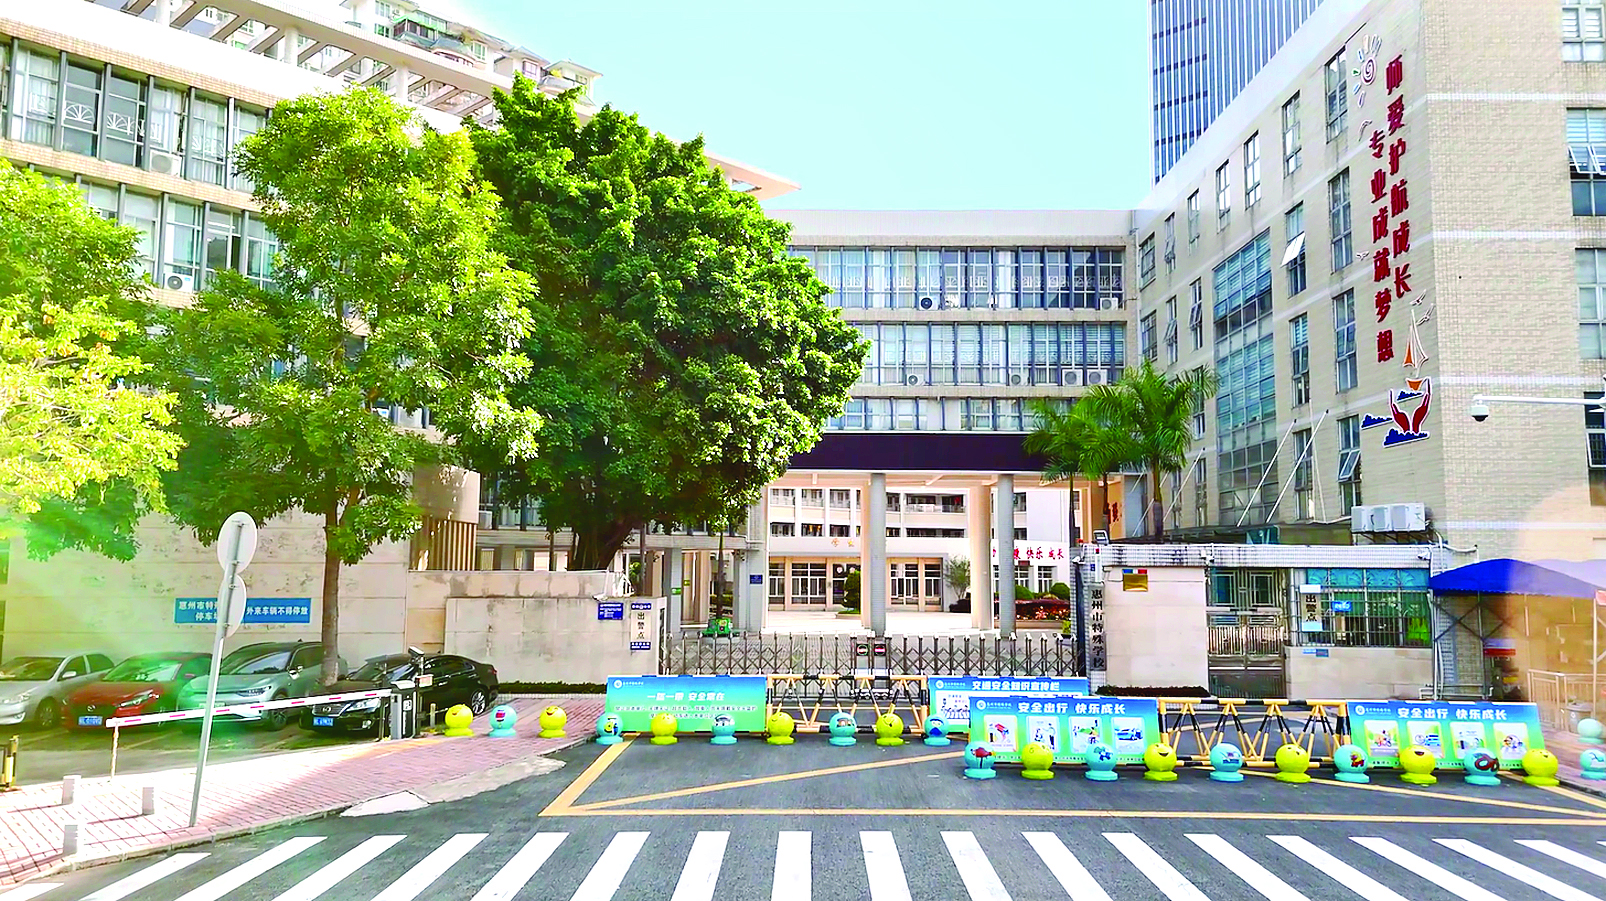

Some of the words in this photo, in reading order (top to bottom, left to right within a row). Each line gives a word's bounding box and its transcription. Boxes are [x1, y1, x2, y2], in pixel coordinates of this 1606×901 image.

[1385, 53, 1412, 299] 师爱护航成长
[1368, 129, 1394, 364] 专业成就梦想
[1026, 546, 1044, 560] 快乐
[1048, 547, 1064, 560] 成长
[246, 606, 308, 616] 外来车辆不得停放
[1305, 594, 1318, 622] 出警点
[972, 680, 1060, 692] 交通安全知识宣传栏
[1018, 702, 1068, 714] 安全出行
[1075, 702, 1126, 715] 快乐成长
[1397, 707, 1448, 720] 安全出行
[1455, 708, 1508, 721] 快乐成长
